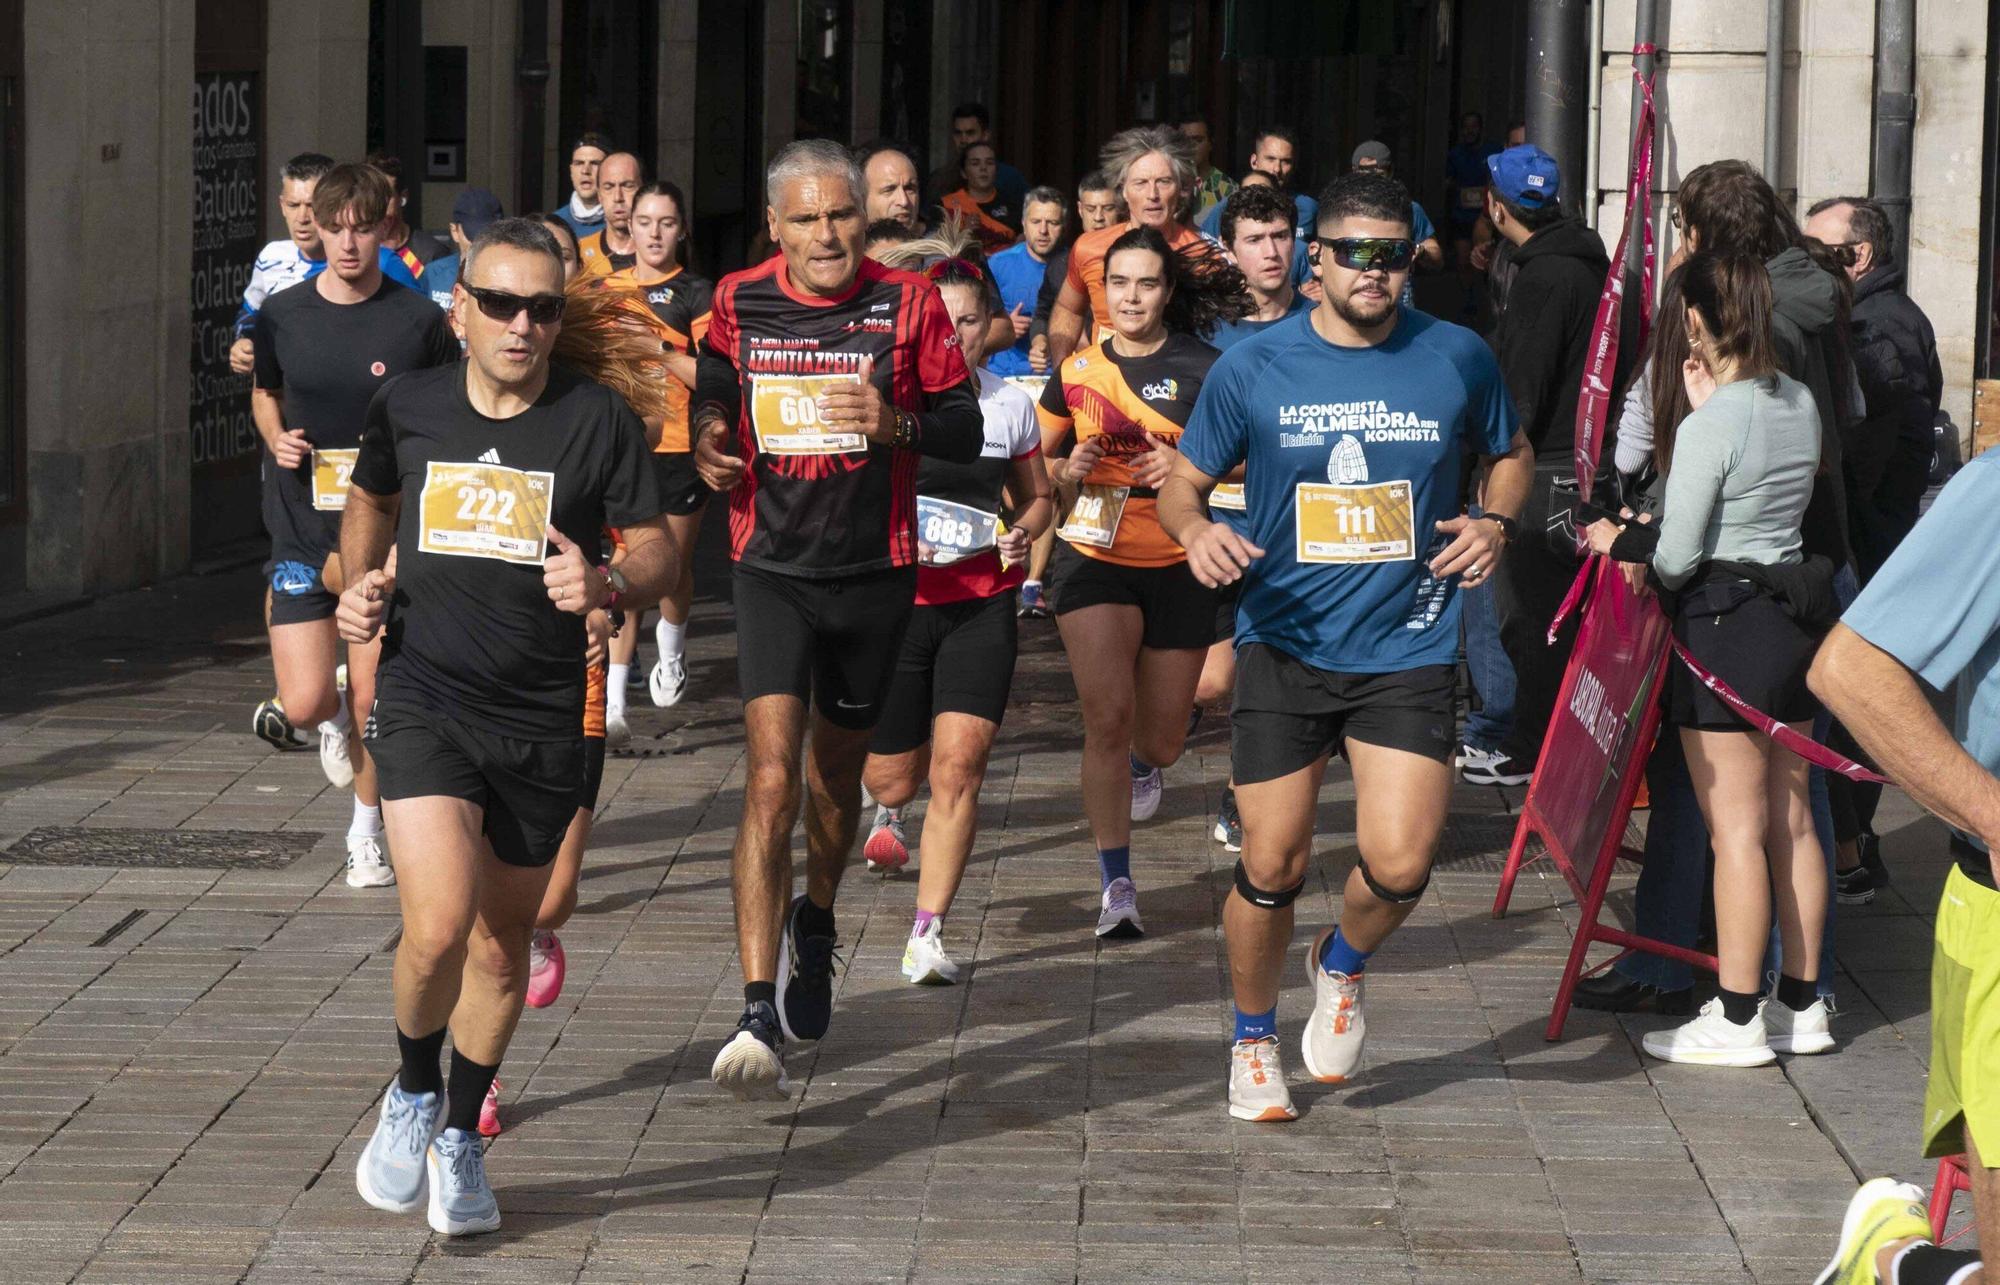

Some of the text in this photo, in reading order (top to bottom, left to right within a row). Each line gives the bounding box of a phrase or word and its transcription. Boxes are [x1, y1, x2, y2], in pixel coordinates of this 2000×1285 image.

[194, 168, 256, 222] Batidos
[863, 318, 893, 334] 2025
[750, 337, 819, 350] 32. MEDIA MARATÓN
[780, 396, 833, 426] 60
[1280, 400, 1388, 418] LA CONQUISTA
[1280, 411, 1439, 433] DE LA ALMENDRA REN
[1289, 433, 1325, 447] Edición
[1364, 428, 1441, 443] KONKISTA
[1389, 488, 1405, 500] 10K
[456, 485, 516, 526] 222
[1334, 505, 1376, 534] 111
[925, 516, 973, 548] 883
[1569, 664, 1606, 737] LABORAL
